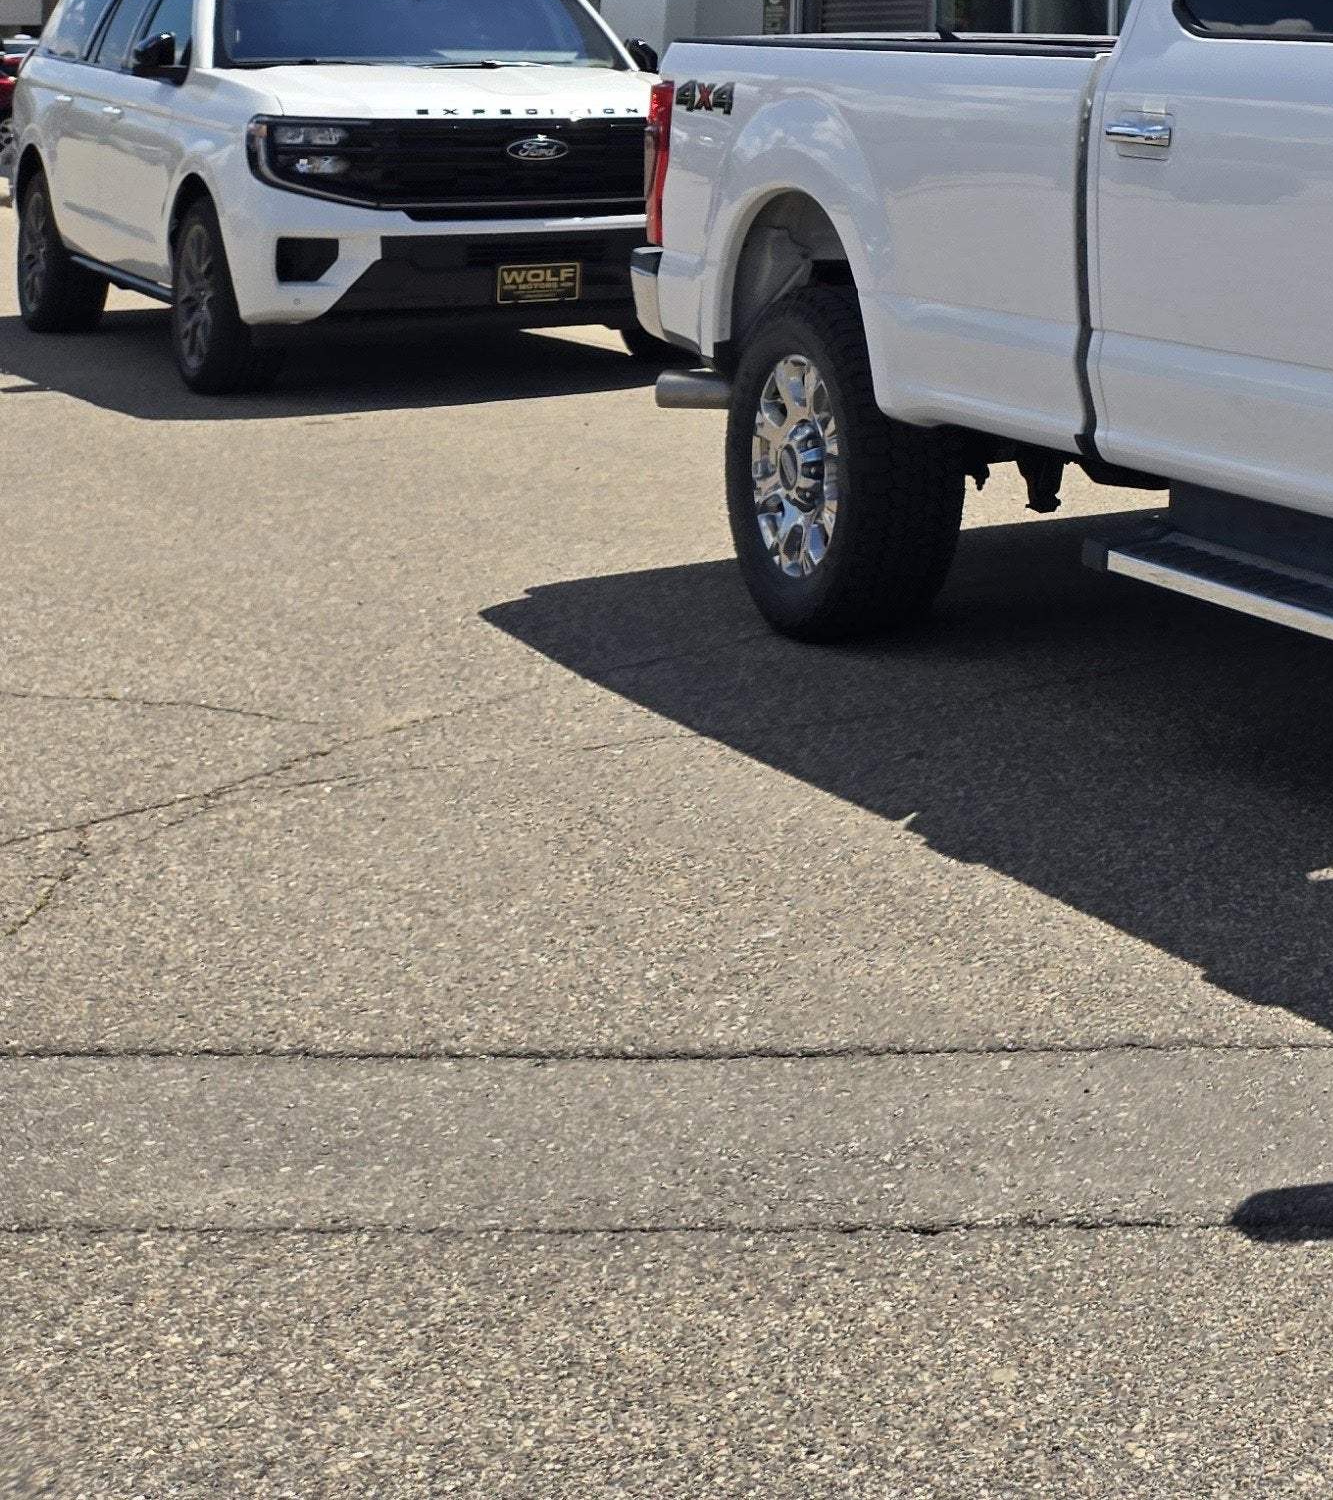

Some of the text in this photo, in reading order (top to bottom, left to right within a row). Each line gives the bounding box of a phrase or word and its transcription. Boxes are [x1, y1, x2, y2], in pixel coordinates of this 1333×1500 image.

[416, 108, 640, 116] EXPEDIION
[518, 141, 558, 158] Ford
[502, 268, 576, 284] WOLF
